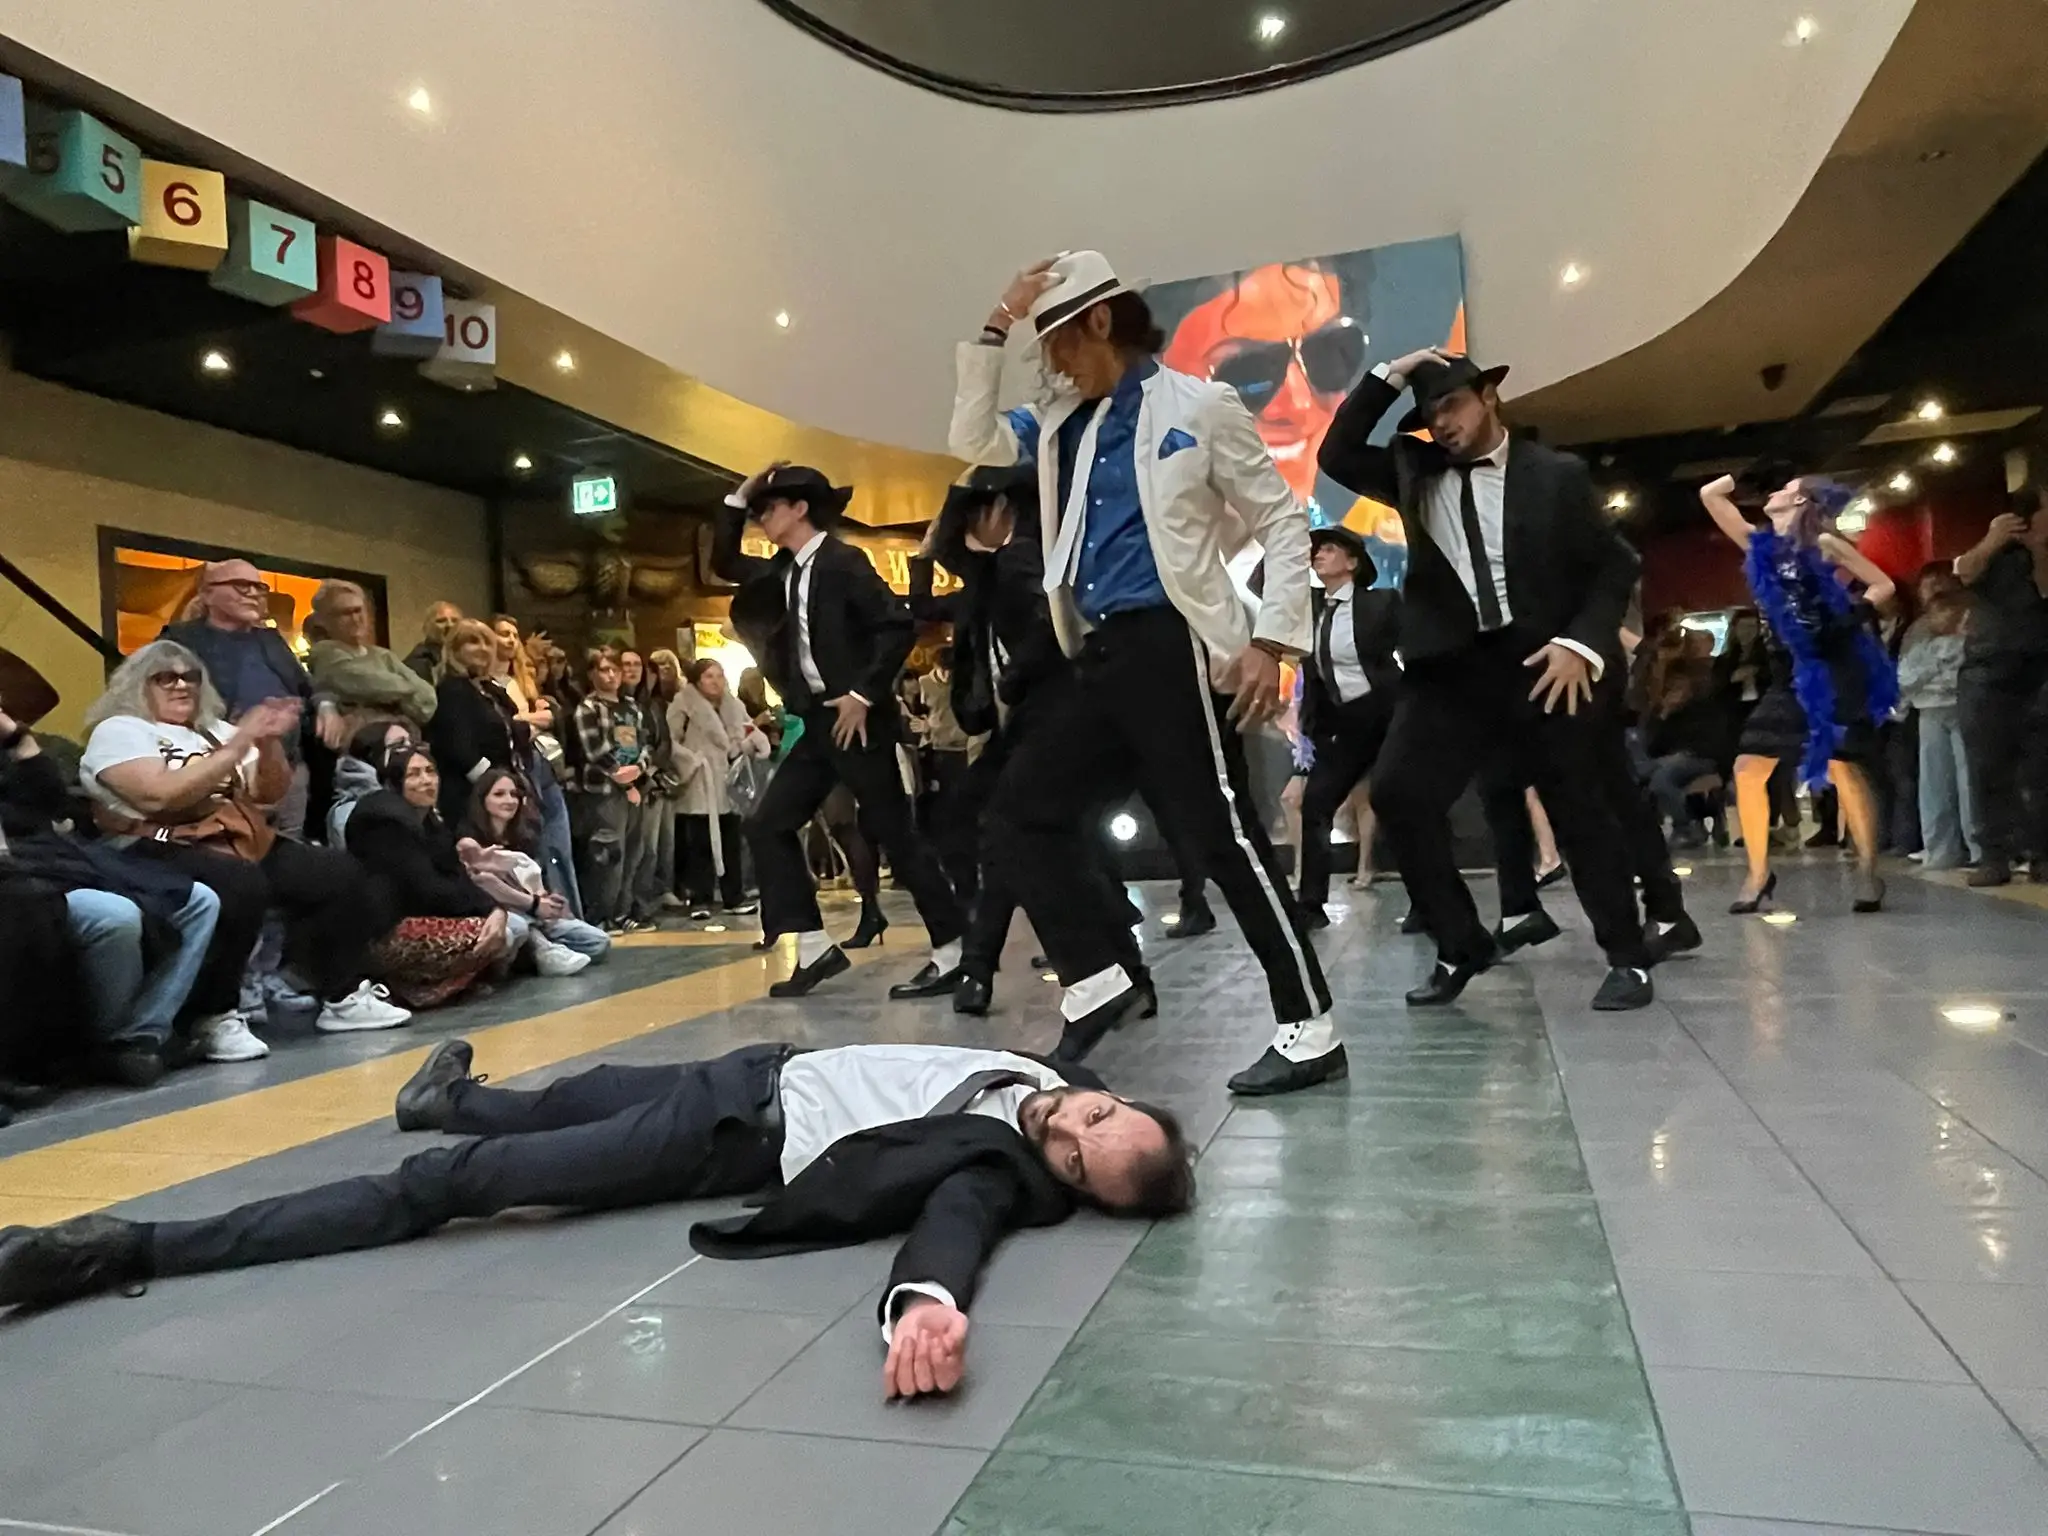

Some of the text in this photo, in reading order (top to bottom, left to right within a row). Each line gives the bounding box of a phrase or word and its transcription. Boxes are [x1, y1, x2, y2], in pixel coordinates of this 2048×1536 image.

[100, 143, 125, 194] 5
[163, 182, 202, 227] 6
[270, 223, 296, 264] 7
[353, 260, 376, 300] 8
[394, 286, 424, 320] 9
[444, 314, 489, 349] 10
